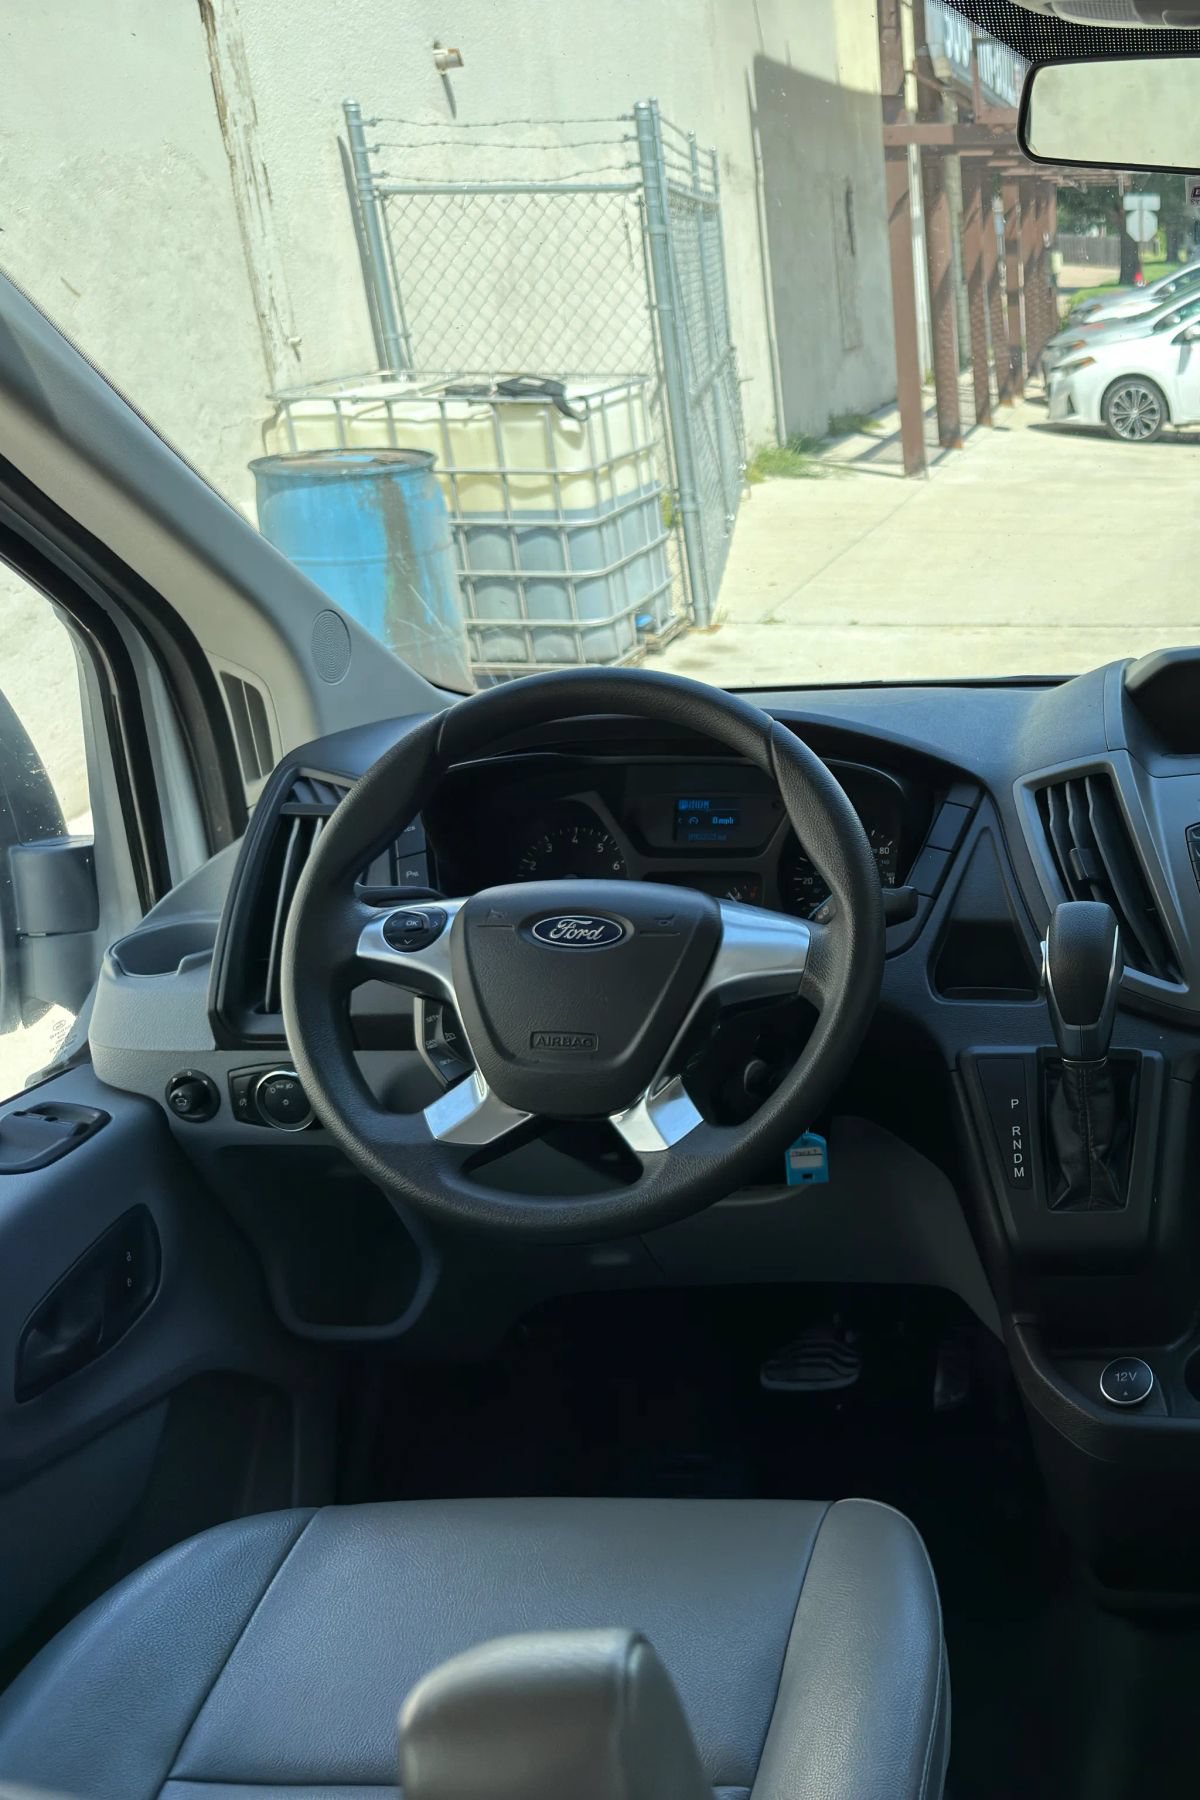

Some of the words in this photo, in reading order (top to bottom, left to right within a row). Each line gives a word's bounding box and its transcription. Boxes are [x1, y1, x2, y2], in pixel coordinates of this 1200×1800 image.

[545, 843, 553, 853] 3
[597, 843, 604, 853] 5
[879, 847, 890, 855] 80
[613, 861, 621, 871] 6
[802, 877, 813, 885] 20
[549, 918, 606, 941] Ford
[535, 1035, 595, 1048] AIRBAG
[1011, 1099, 1020, 1109] P
[1012, 1126, 1021, 1136] R
[1013, 1139, 1022, 1150] N
[1013, 1153, 1023, 1164] D
[1014, 1166, 1025, 1178] M
[1115, 1371, 1137, 1382] 12V
